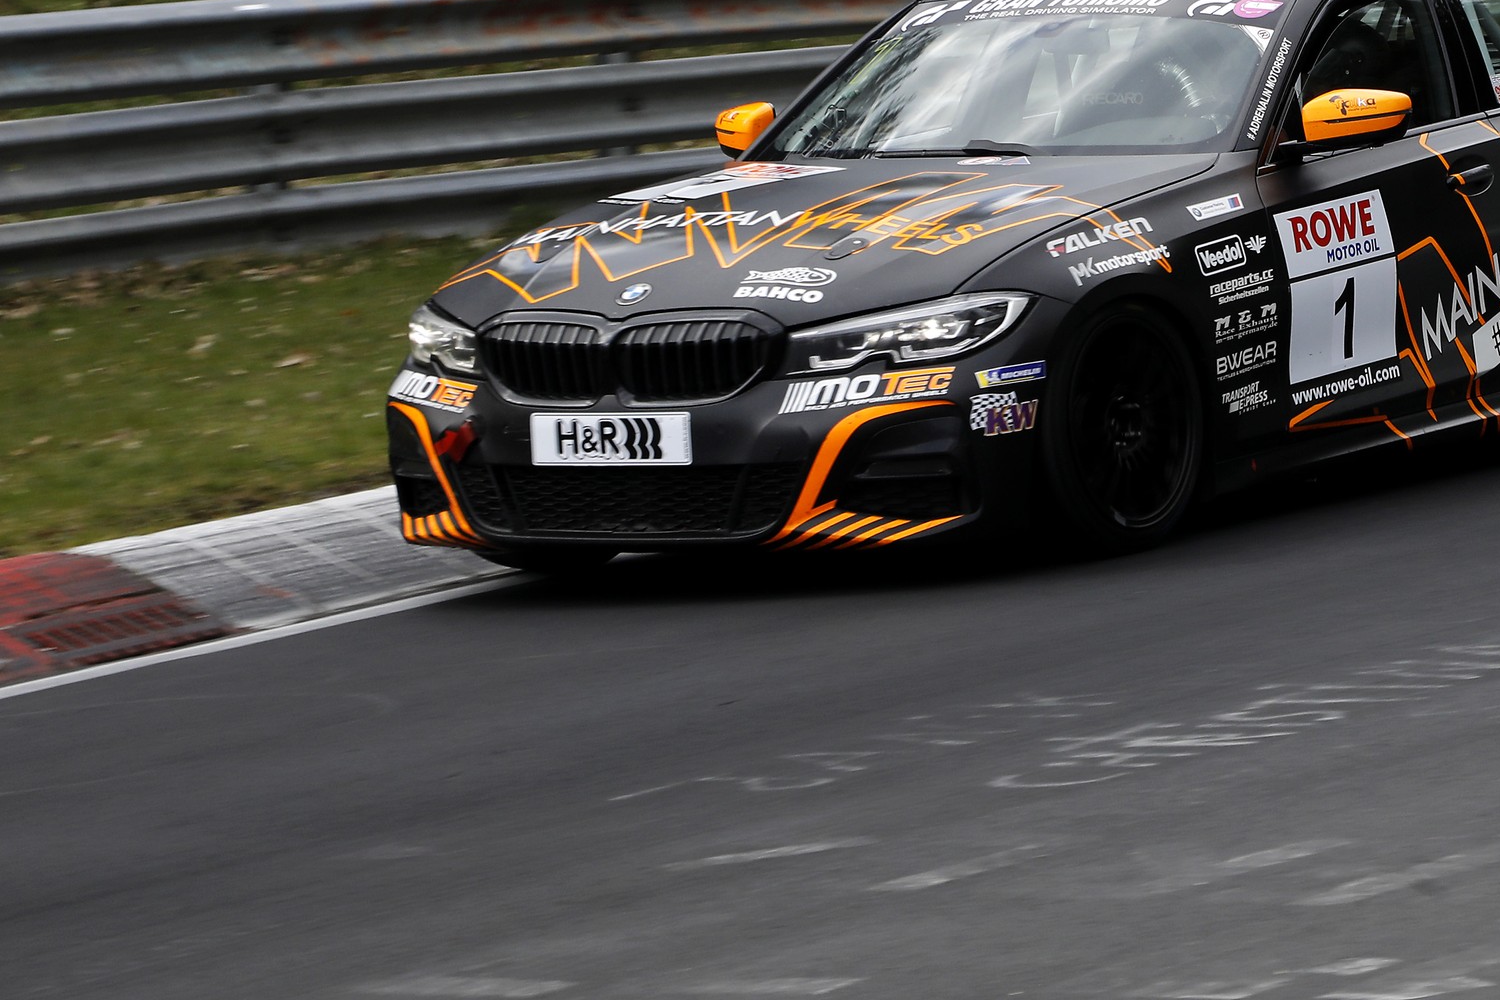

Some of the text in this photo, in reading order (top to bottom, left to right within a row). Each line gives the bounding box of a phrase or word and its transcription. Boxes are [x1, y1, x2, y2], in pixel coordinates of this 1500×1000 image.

[964, 7, 1157, 21] THE REAL DRIVING SIMULATOR
[1265, 37, 1293, 90] MOTORSPORT
[1045, 217, 1154, 258] FALKEN
[1287, 199, 1376, 254] ROWE
[1199, 242, 1243, 269] Veedol
[1327, 238, 1380, 264] MOTOR OIL
[733, 285, 825, 304] BAHCO
[1209, 268, 1274, 295] raceparts.cc
[1215, 315, 1279, 338] Race Exhaust
[1334, 276, 1356, 360] 1
[1000, 366, 1042, 380] MICHELIN
[1216, 340, 1278, 375] BWEAR
[1292, 364, 1401, 406] www.rowe-oil.com
[556, 418, 623, 458] H&R
